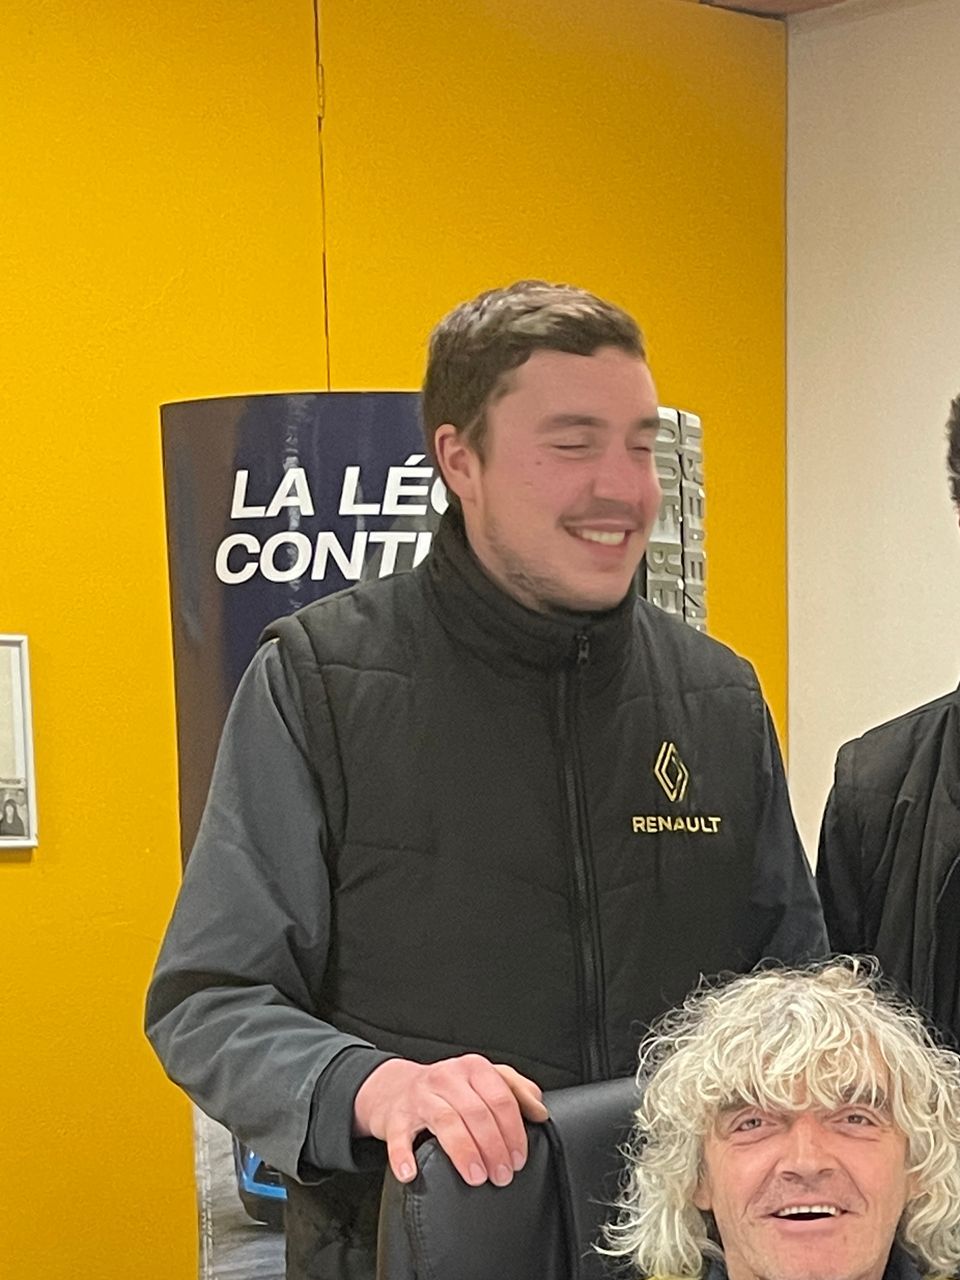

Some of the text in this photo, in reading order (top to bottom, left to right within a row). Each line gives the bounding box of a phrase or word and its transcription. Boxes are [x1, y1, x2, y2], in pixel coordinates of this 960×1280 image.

[231, 467, 314, 519] LA
[215, 531, 432, 584] CONTI
[632, 816, 721, 832] RENAULT
